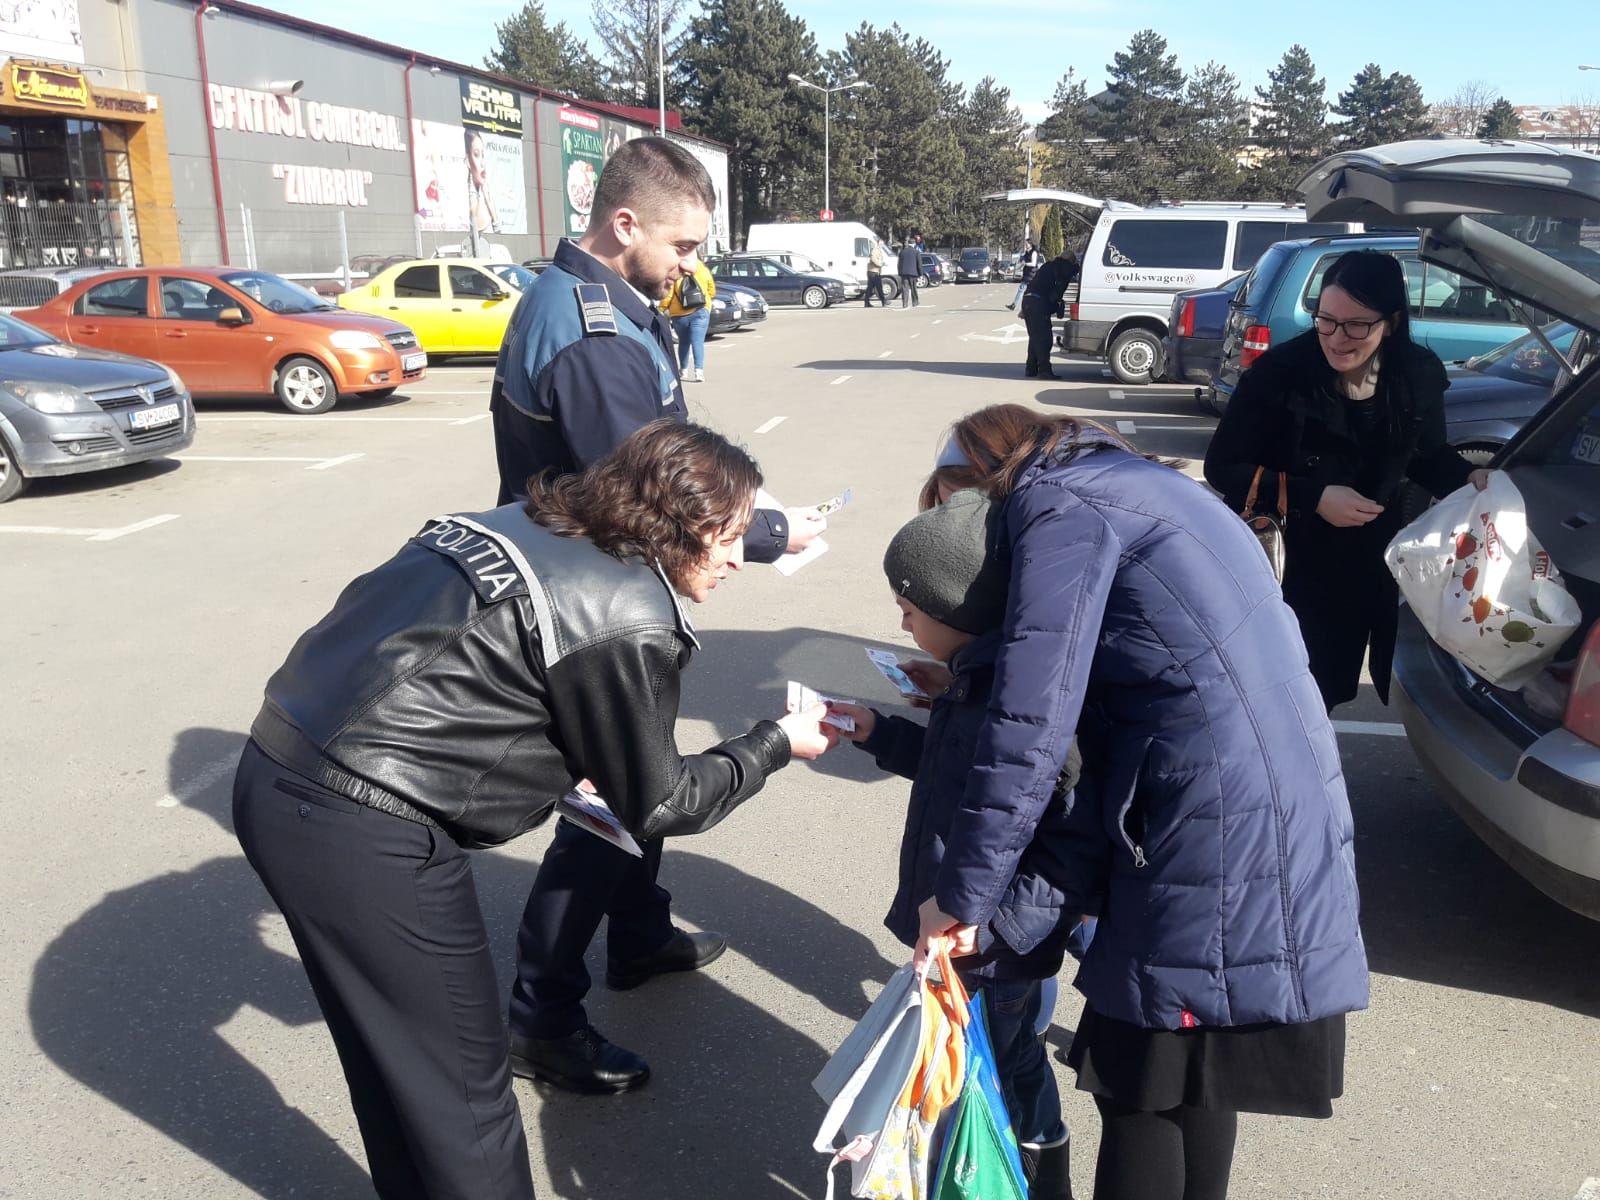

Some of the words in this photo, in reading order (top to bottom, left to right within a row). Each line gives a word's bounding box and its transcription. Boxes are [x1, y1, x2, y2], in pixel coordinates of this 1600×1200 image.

[468, 82, 515, 108] SCHIMB
[462, 96, 522, 123] VALUTAR
[306, 101, 407, 152] COMERCIAL
[573, 131, 603, 153] SPARTAN
[1116, 272, 1184, 285] Volkswagen
